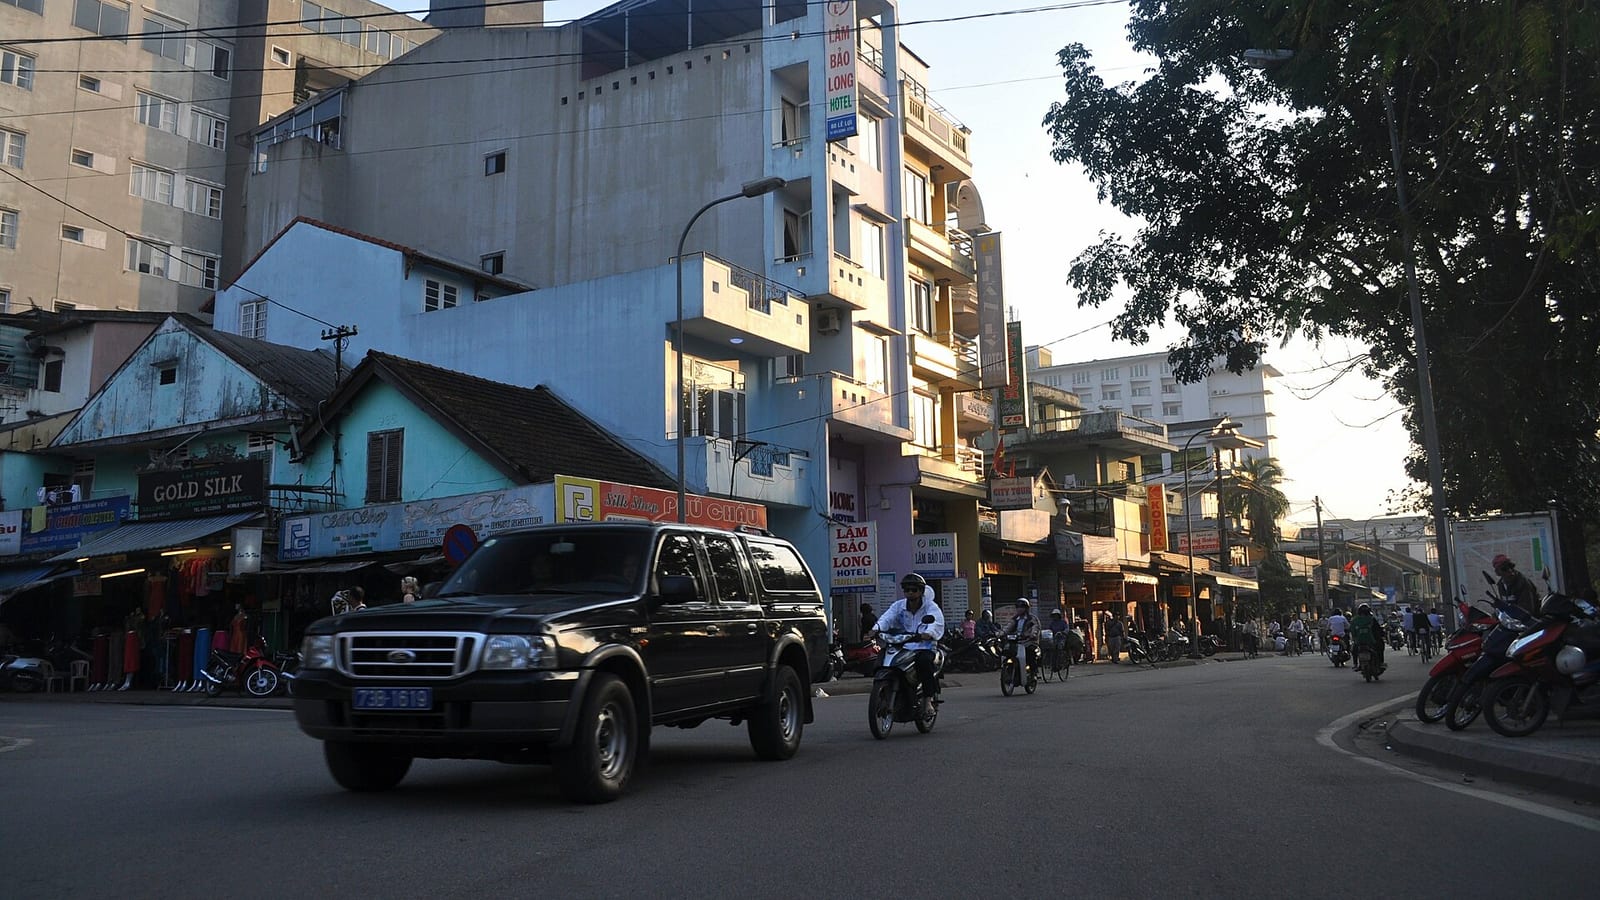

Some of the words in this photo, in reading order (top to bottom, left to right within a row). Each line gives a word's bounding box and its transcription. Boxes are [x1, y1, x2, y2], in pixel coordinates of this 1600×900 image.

[829, 24, 850, 43] LÂM
[830, 47, 850, 68] BẢO
[828, 73, 853, 92] LONG
[830, 95, 852, 112] HOTEL
[153, 481, 199, 502] GOLD
[204, 474, 243, 496] SILK
[605, 493, 628, 509] Silk
[630, 495, 659, 514] Shop
[707, 503, 759, 525] CHÂU
[1151, 501, 1163, 546] KODAK
[836, 525, 868, 540] LÂM
[838, 538, 868, 553] BẢO
[929, 538, 949, 547] HOTEL
[833, 555, 872, 569] LONG
[915, 551, 926, 564] LÂM
[928, 550, 938, 564] BẢO
[939, 551, 953, 563] LONG
[837, 568, 868, 577] HOTEL
